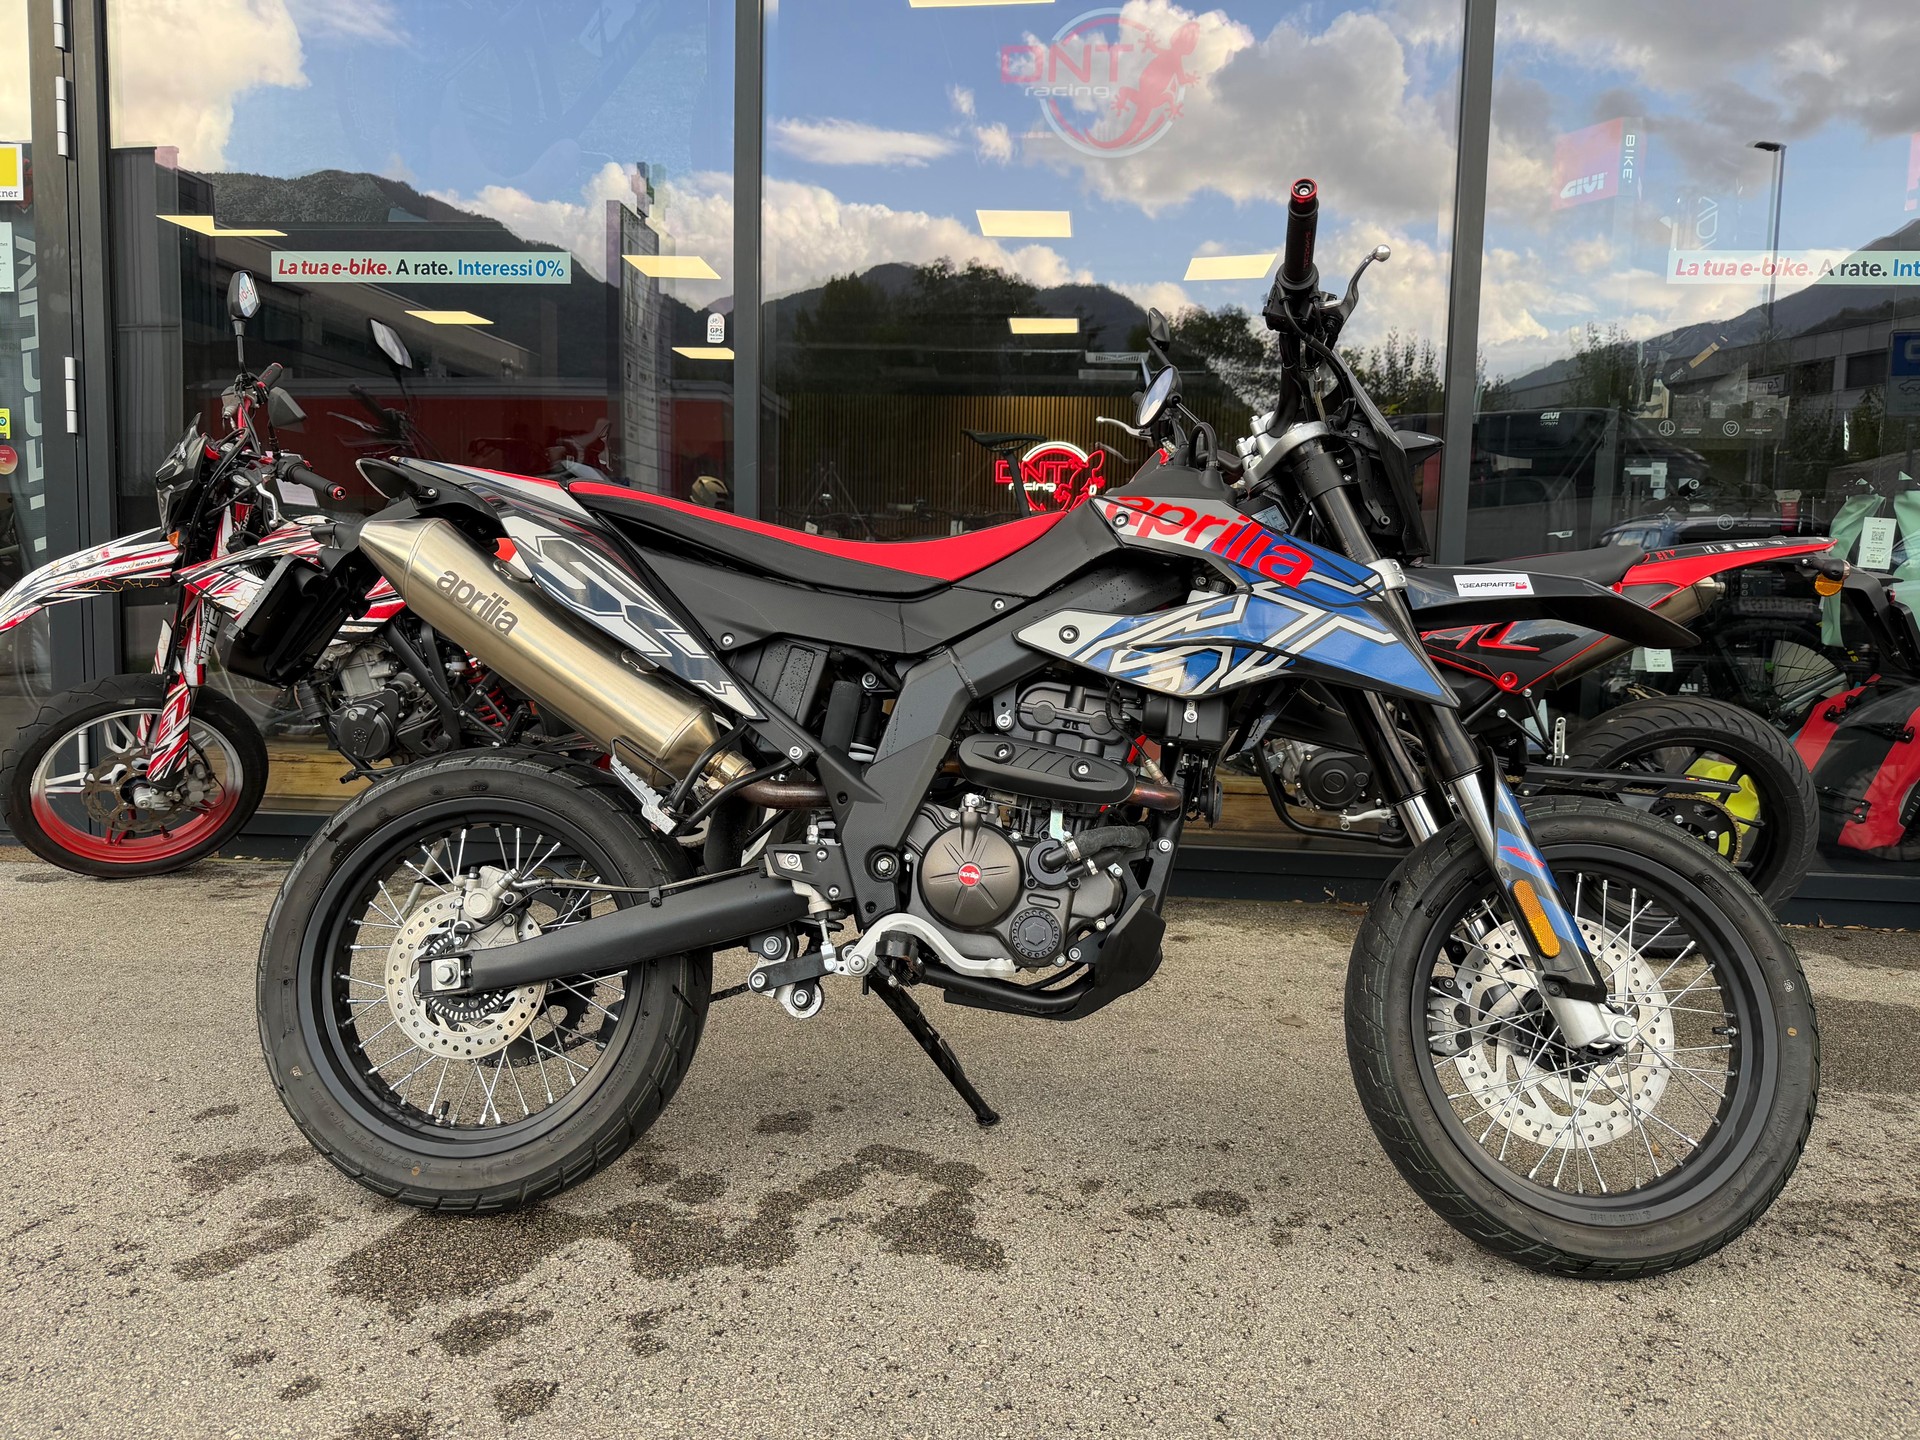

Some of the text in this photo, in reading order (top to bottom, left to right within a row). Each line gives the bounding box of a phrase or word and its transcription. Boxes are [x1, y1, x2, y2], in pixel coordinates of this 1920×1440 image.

[1001, 43, 1134, 84] DNT
[1025, 83, 1110, 99] racing
[1622, 134, 1636, 180] BIKE
[1559, 172, 1605, 200] GIVI
[278, 258, 565, 277] La tua e-bike. A rate. Interessi 0%
[1675, 257, 1700, 276] La
[1703, 259, 1738, 276] tua
[1740, 257, 1814, 277] e-bike.
[1817, 258, 1835, 276] A
[1839, 259, 1888, 277] rate.
[1008, 481, 1057, 493] rcing
[1104, 495, 1314, 589] aprilia
[436, 570, 519, 637] aprilia
